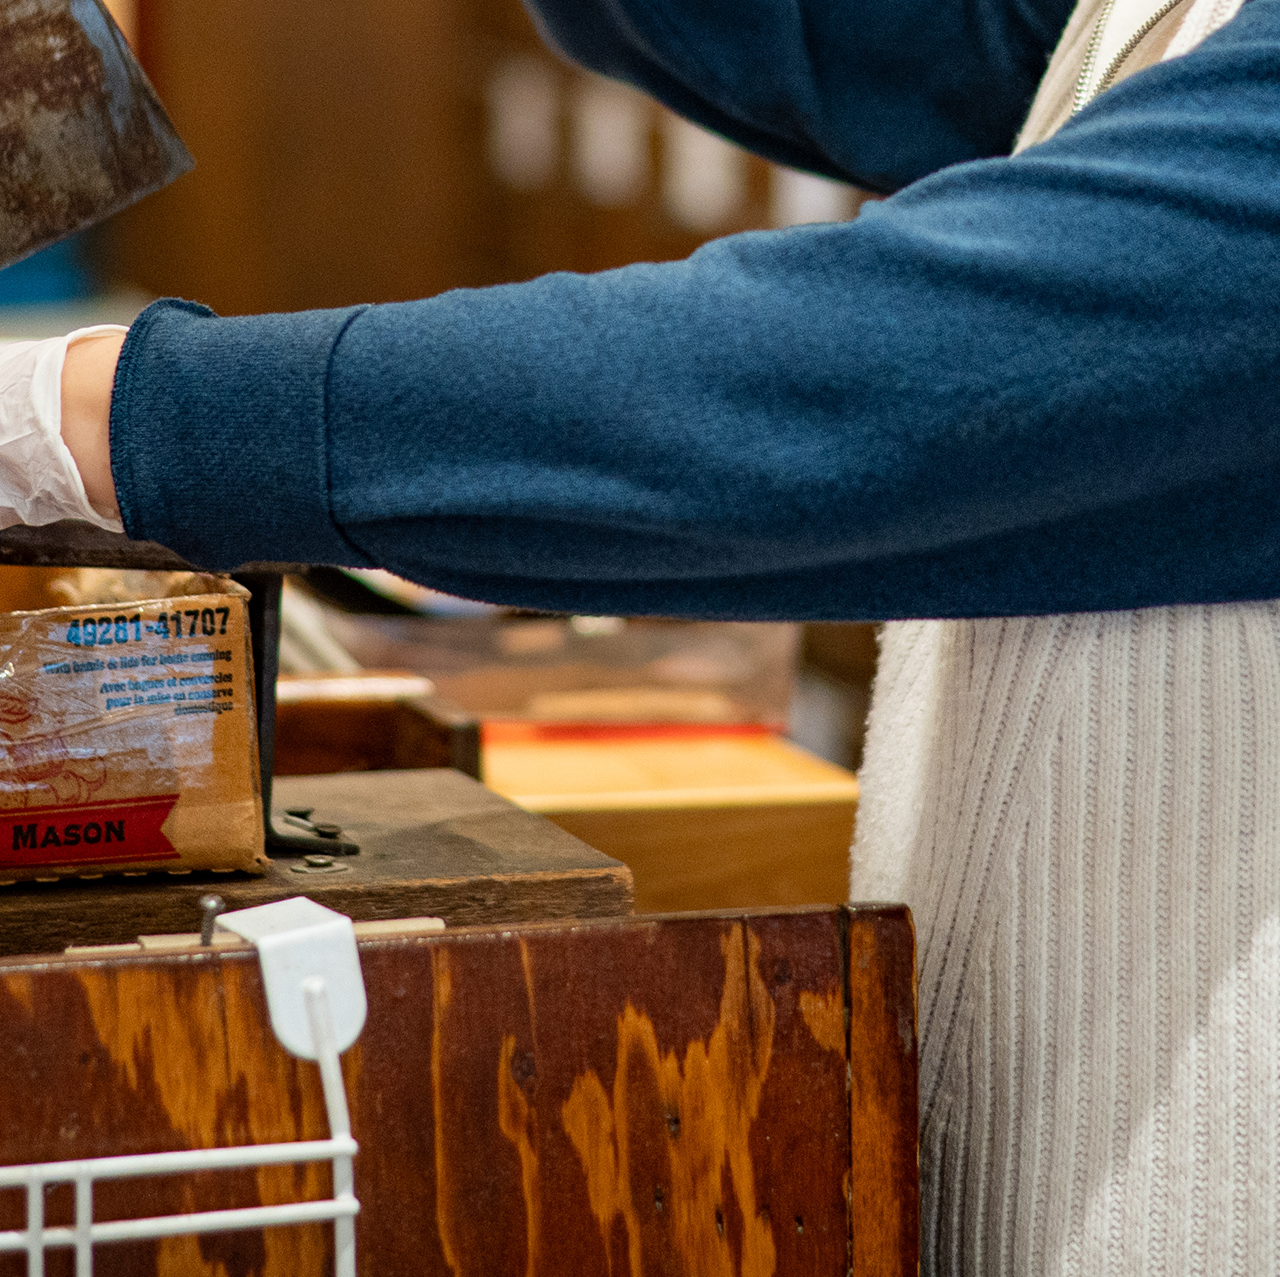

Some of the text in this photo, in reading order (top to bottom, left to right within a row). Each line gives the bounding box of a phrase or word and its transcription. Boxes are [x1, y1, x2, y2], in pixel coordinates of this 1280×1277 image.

[66, 606, 231, 647] 49281-41707
[120, 656, 139, 669] lids
[141, 654, 158, 667] for
[190, 650, 232, 663] canning
[100, 672, 233, 694] Avec bagues et couvercles
[106, 687, 233, 710] pour la mise en conserve
